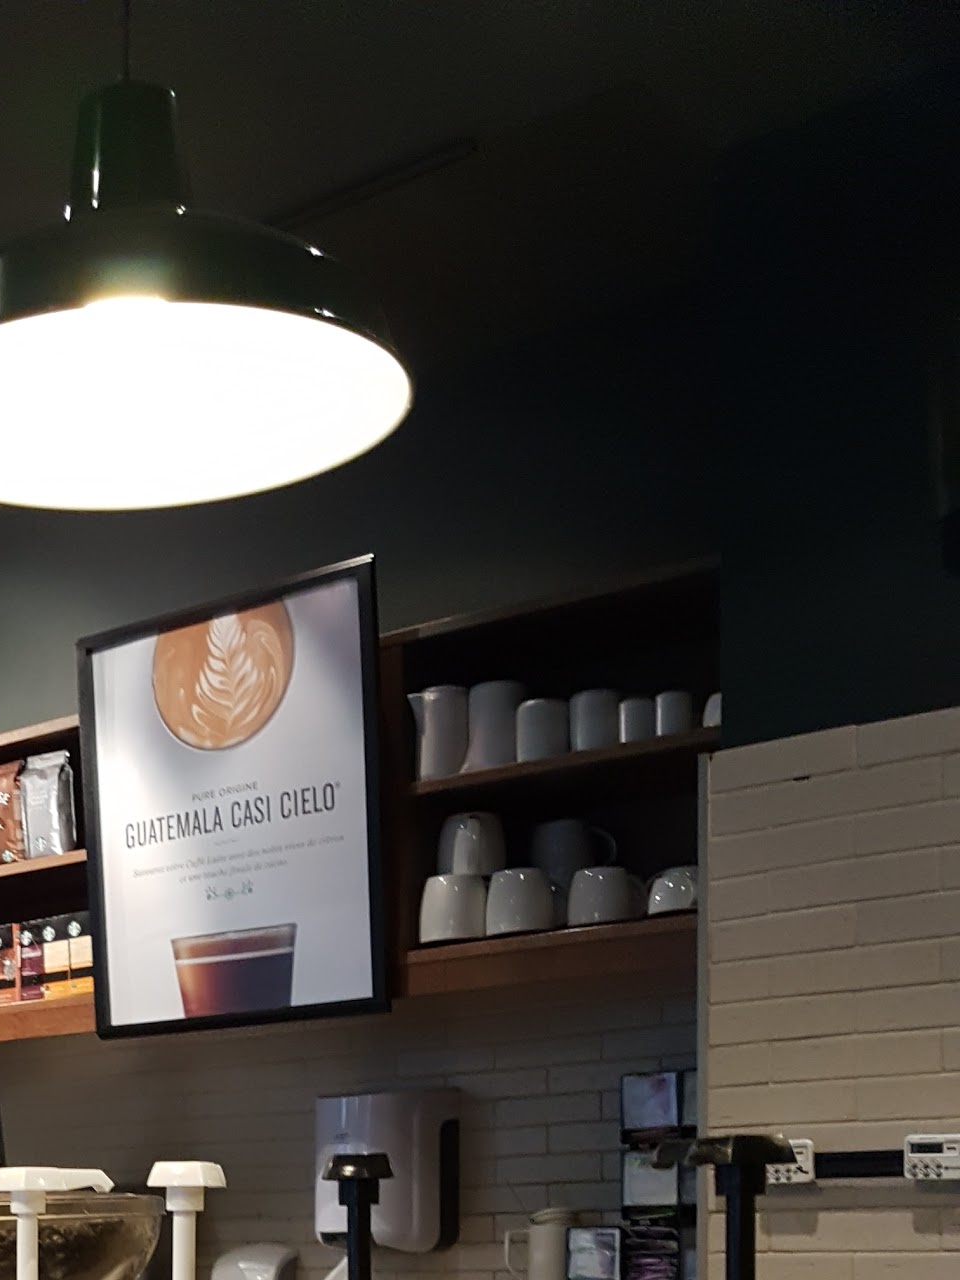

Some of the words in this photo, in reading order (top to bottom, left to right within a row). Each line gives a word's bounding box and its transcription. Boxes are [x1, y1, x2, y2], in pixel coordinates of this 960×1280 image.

[192, 788, 215, 802] PURE
[218, 780, 259, 798] ORIGINE
[125, 805, 224, 850] GUATEMALA
[231, 795, 272, 829] CASI
